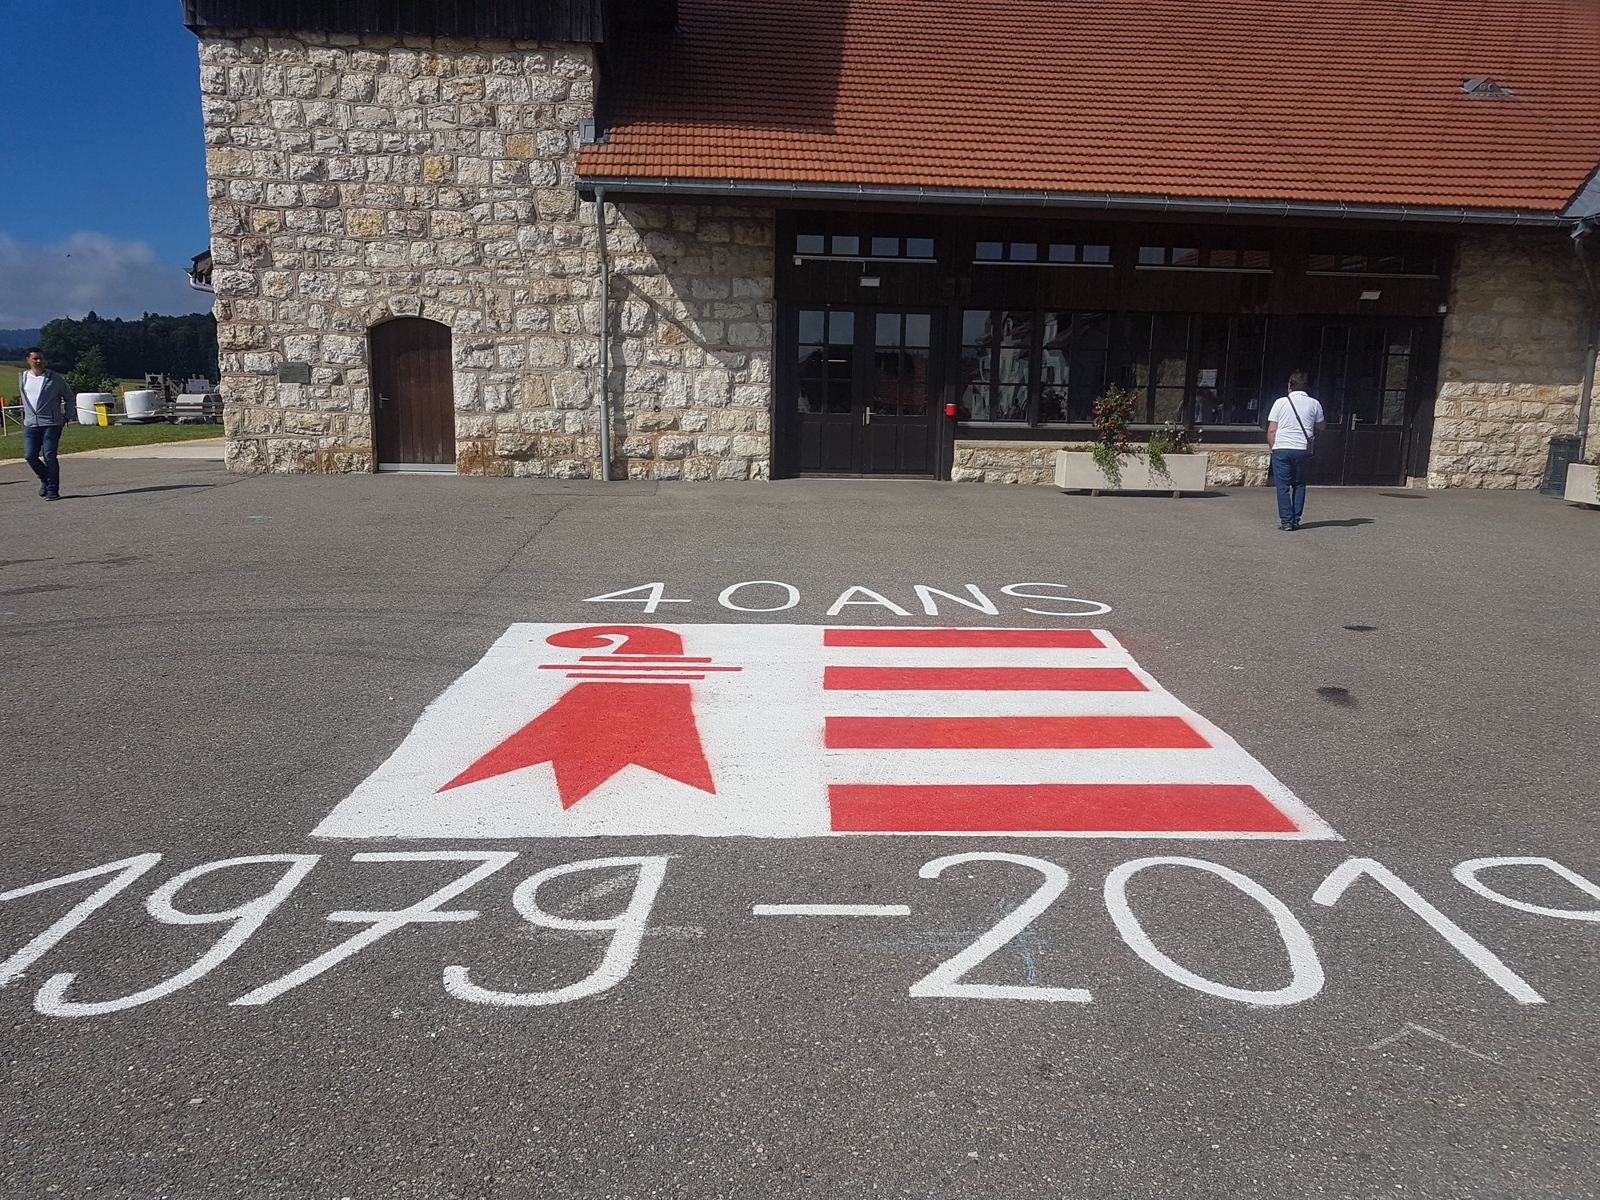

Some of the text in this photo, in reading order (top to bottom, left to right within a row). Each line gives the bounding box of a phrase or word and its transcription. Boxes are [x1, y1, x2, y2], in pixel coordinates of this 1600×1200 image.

[582, 581, 1113, 617] 40 ANS
[0, 851, 675, 1017] 1979
